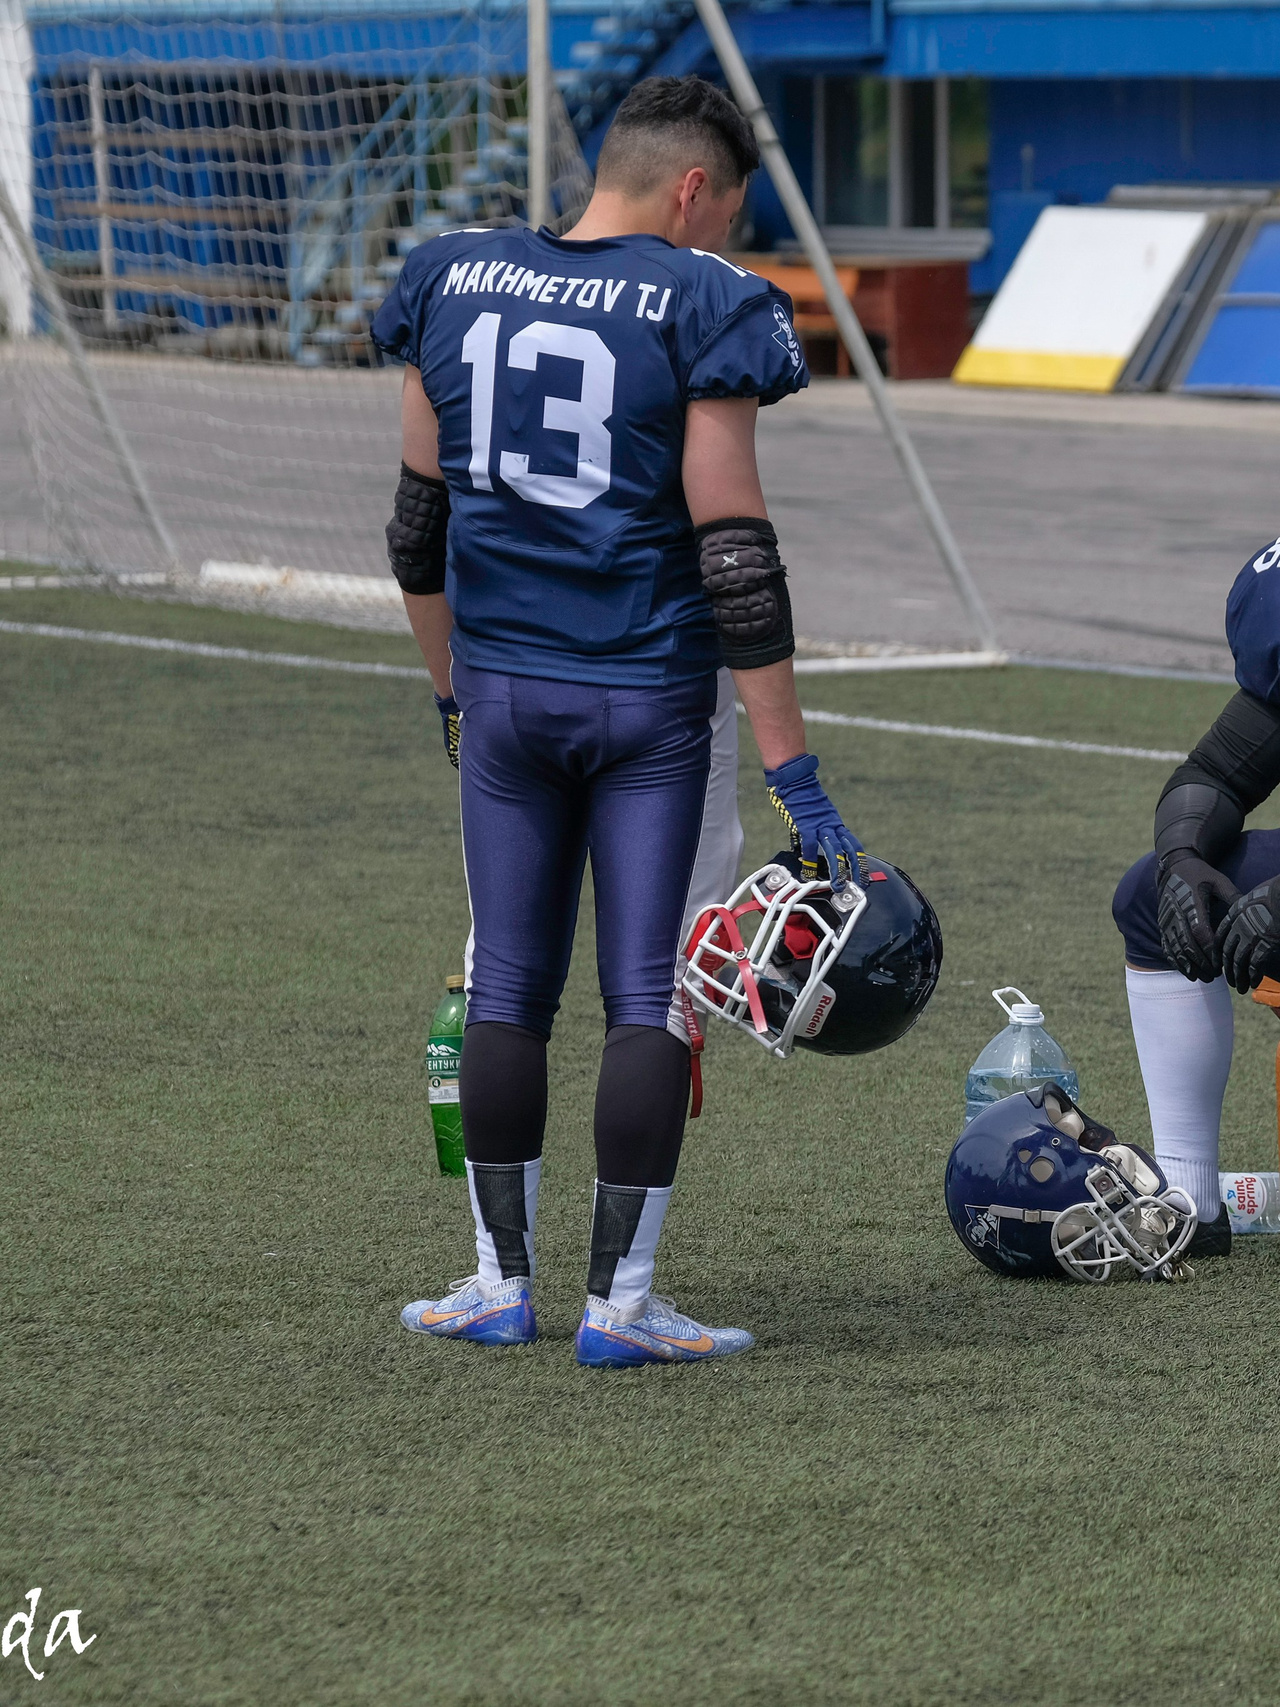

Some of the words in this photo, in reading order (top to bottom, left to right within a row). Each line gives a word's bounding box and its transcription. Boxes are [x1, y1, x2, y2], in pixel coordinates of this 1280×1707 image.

[442, 260, 627, 313] MAKHMETOV
[635, 282, 672, 322] TJ
[461, 311, 616, 509] 13
[805, 995, 833, 1035] Riddell
[1234, 1180, 1246, 1210] saint
[1244, 1177, 1259, 1215] spring
